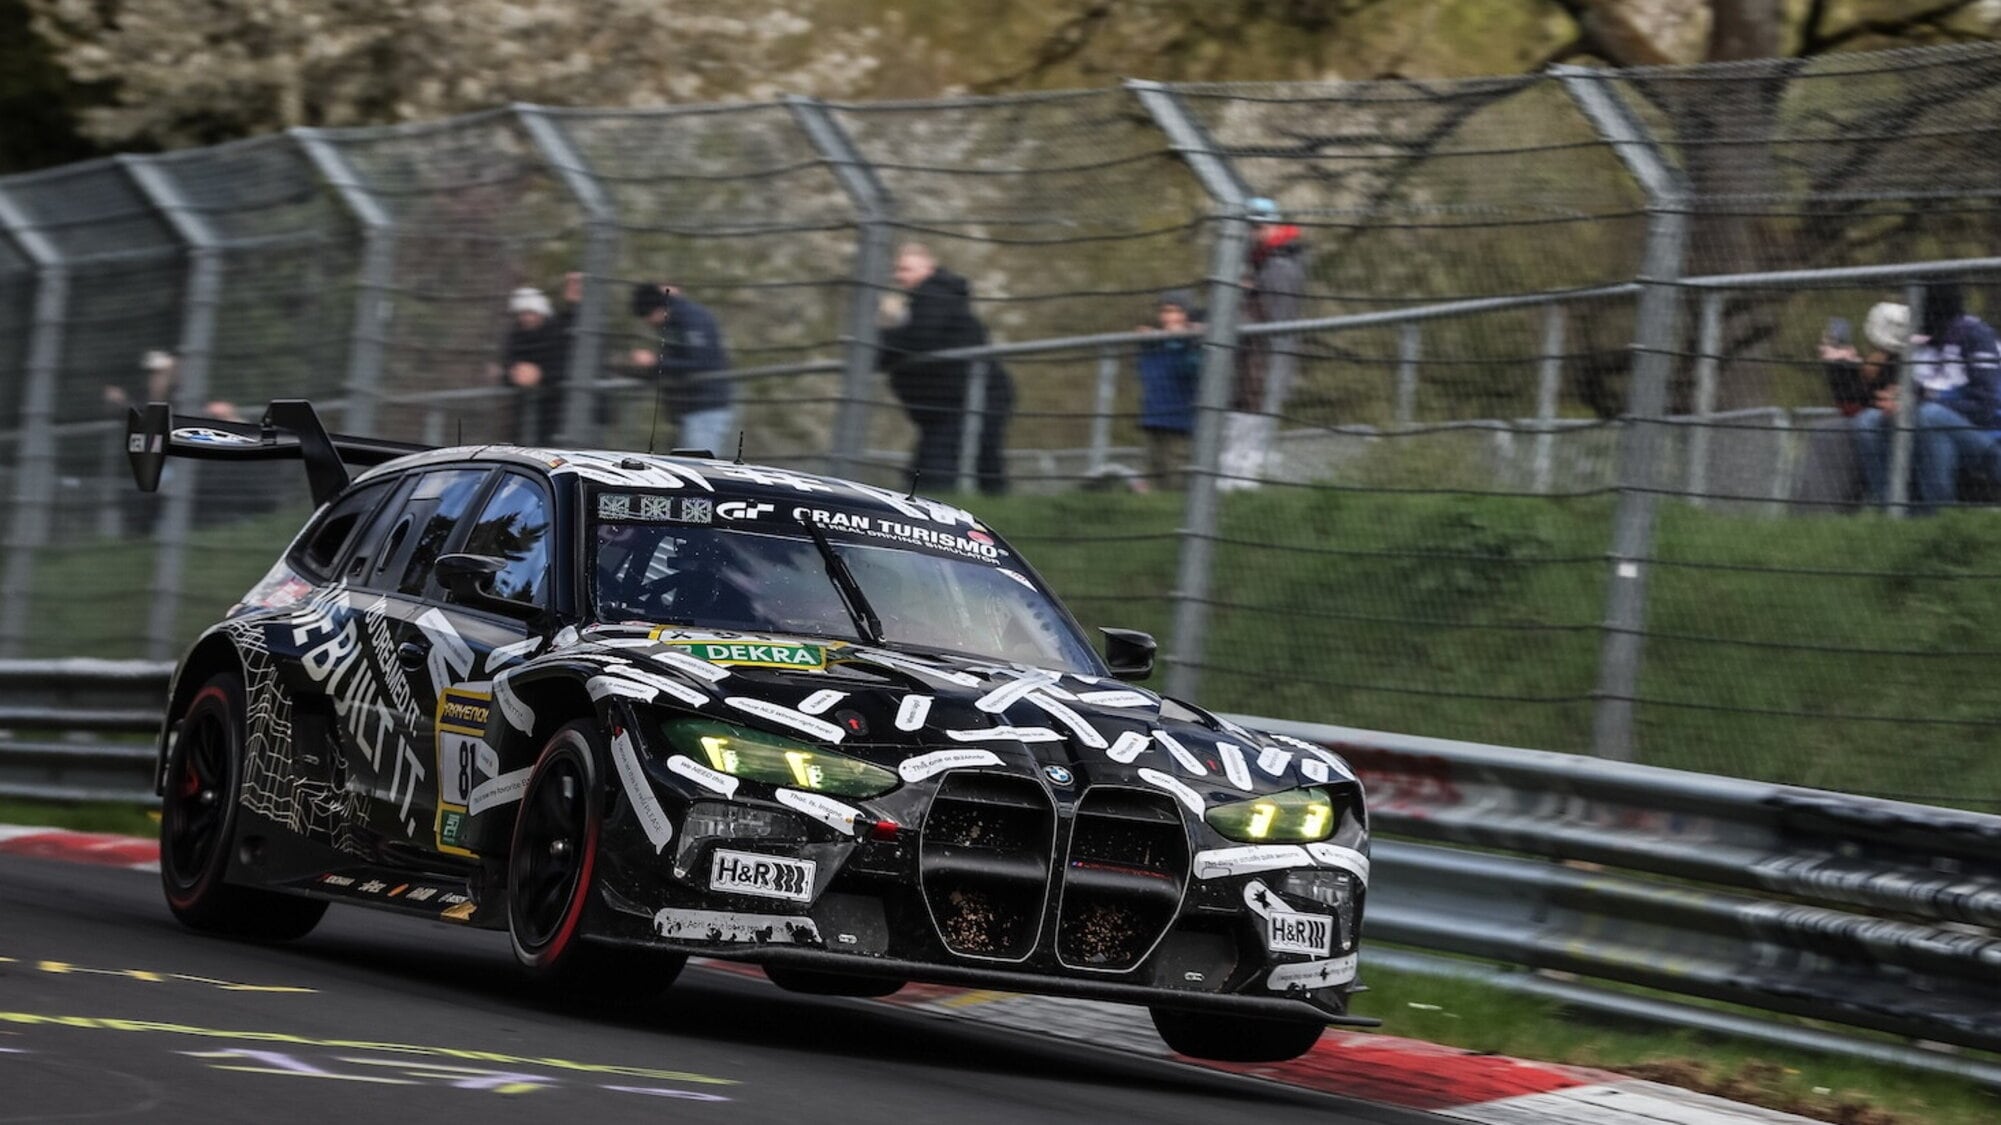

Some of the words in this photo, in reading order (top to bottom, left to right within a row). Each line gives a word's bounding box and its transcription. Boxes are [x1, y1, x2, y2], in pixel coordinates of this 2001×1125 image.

[792, 507, 870, 529] GRAN
[797, 520, 826, 530] TE
[828, 523, 866, 535] REAL
[867, 529, 923, 546] DRIVING
[925, 541, 1001, 566] SIMULATOR
[706, 644, 817, 665] DEKRA
[371, 617, 411, 713] DREAMED
[404, 697, 420, 737] IT.
[300, 616, 394, 774] BUILT
[389, 734, 425, 838] IT.
[459, 741, 476, 801] 81
[692, 766, 712, 779] NEED
[912, 761, 929, 772] This
[643, 803, 662, 832] PLEASE
[718, 857, 770, 887] H&R
[1272, 917, 1306, 944] H&R
